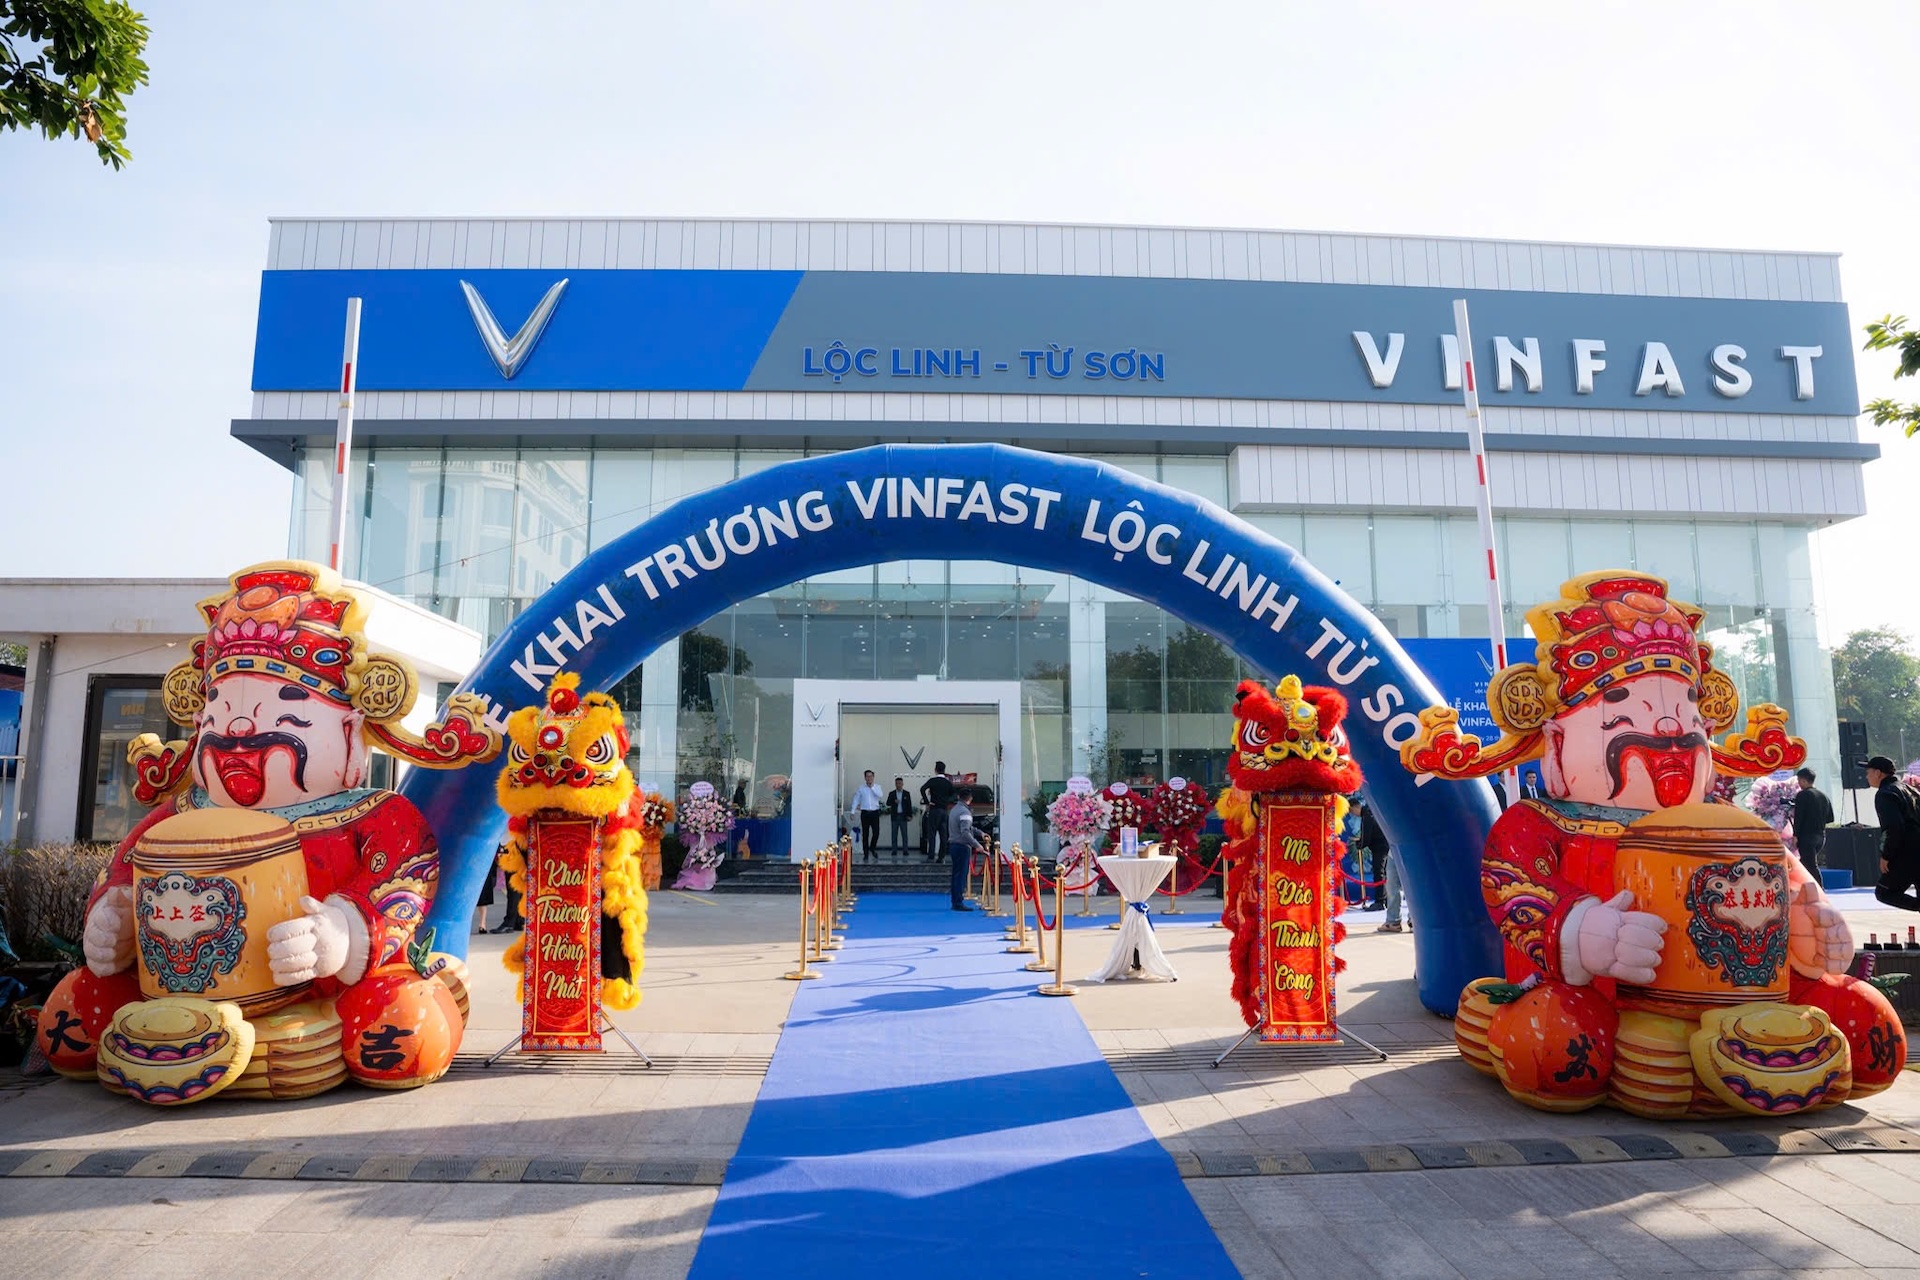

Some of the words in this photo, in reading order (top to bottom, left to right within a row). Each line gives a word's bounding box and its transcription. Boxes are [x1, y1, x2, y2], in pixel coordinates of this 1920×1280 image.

[803, 340, 879, 383] LỘC
[890, 348, 981, 377] LINH
[1019, 343, 1074, 379] TỪ
[1083, 347, 1165, 380] SƠN
[1352, 331, 1823, 400] VINFAST
[510, 583, 626, 692] KHAI
[624, 490, 834, 601] TRƯƠNG
[846, 477, 1062, 531] VINFAST
[1081, 499, 1182, 566] LỘC
[1182, 539, 1299, 633] LINH
[1305, 618, 1381, 685] TỪ
[1281, 835, 1312, 866] Mã
[544, 859, 586, 887] Khai
[1276, 878, 1313, 905] Đáo
[541, 933, 586, 971] Hồng
[1271, 920, 1321, 947] Thành
[543, 970, 586, 1000] Phát
[1274, 961, 1316, 1000] Công
[46, 1010, 91, 1055] 大
[360, 1024, 414, 1070] 吉
